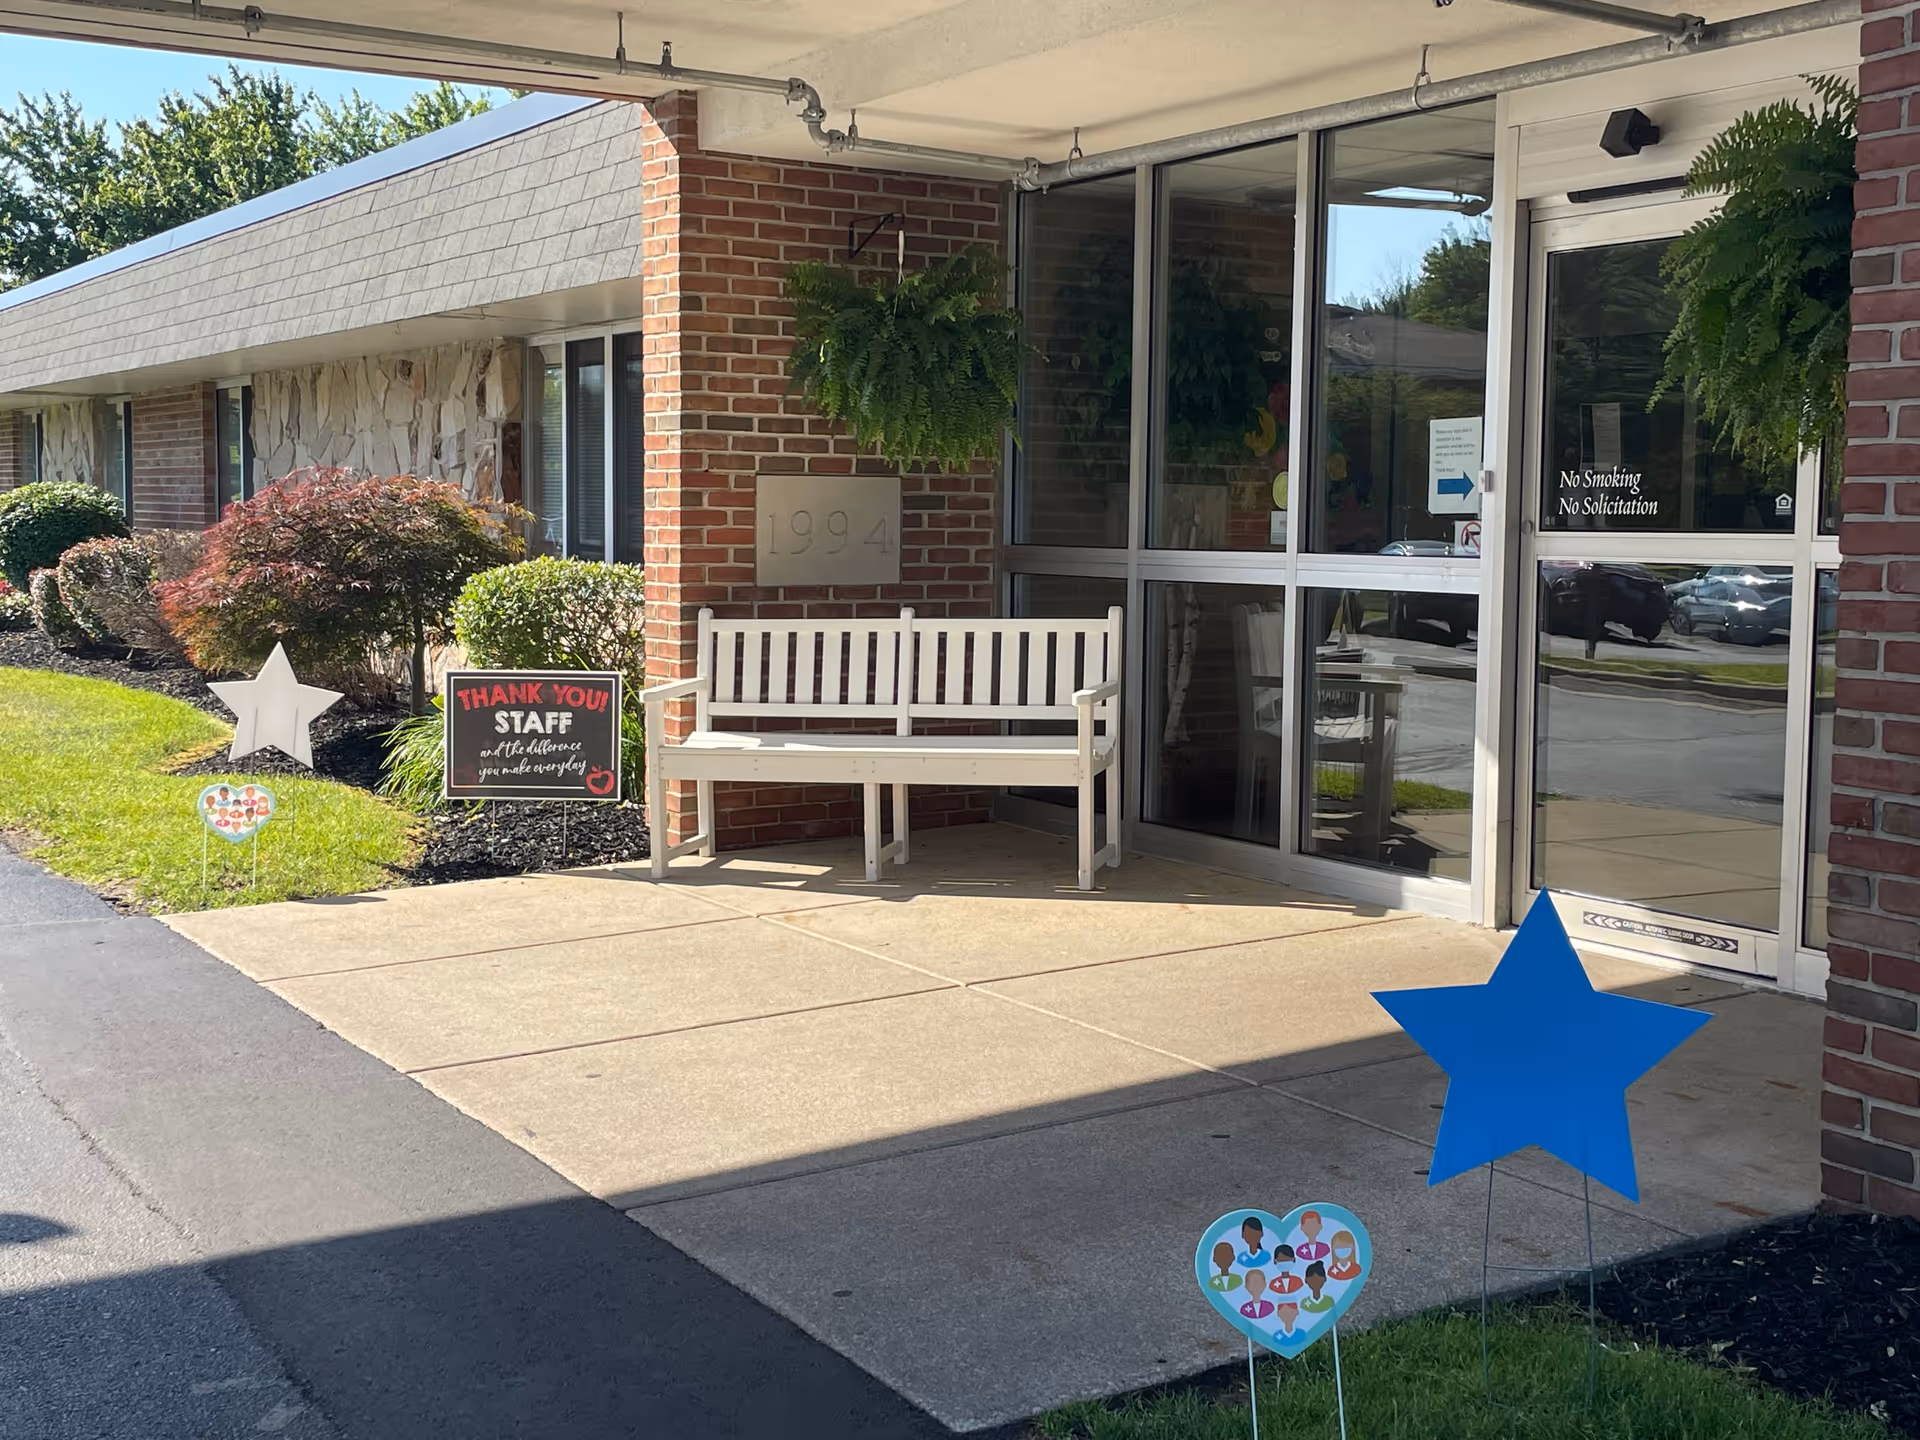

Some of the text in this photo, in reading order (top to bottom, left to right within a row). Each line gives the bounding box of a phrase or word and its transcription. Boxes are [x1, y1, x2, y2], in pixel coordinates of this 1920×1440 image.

[1559, 465, 1642, 495] No Smoking
[1558, 492, 1658, 516] No Solicitation
[768, 509, 894, 555] 1994
[457, 682, 609, 713] THANK YOU!
[494, 710, 573, 735] STAFF
[480, 737, 582, 759] and the difference
[478, 754, 586, 784] you make everyday
